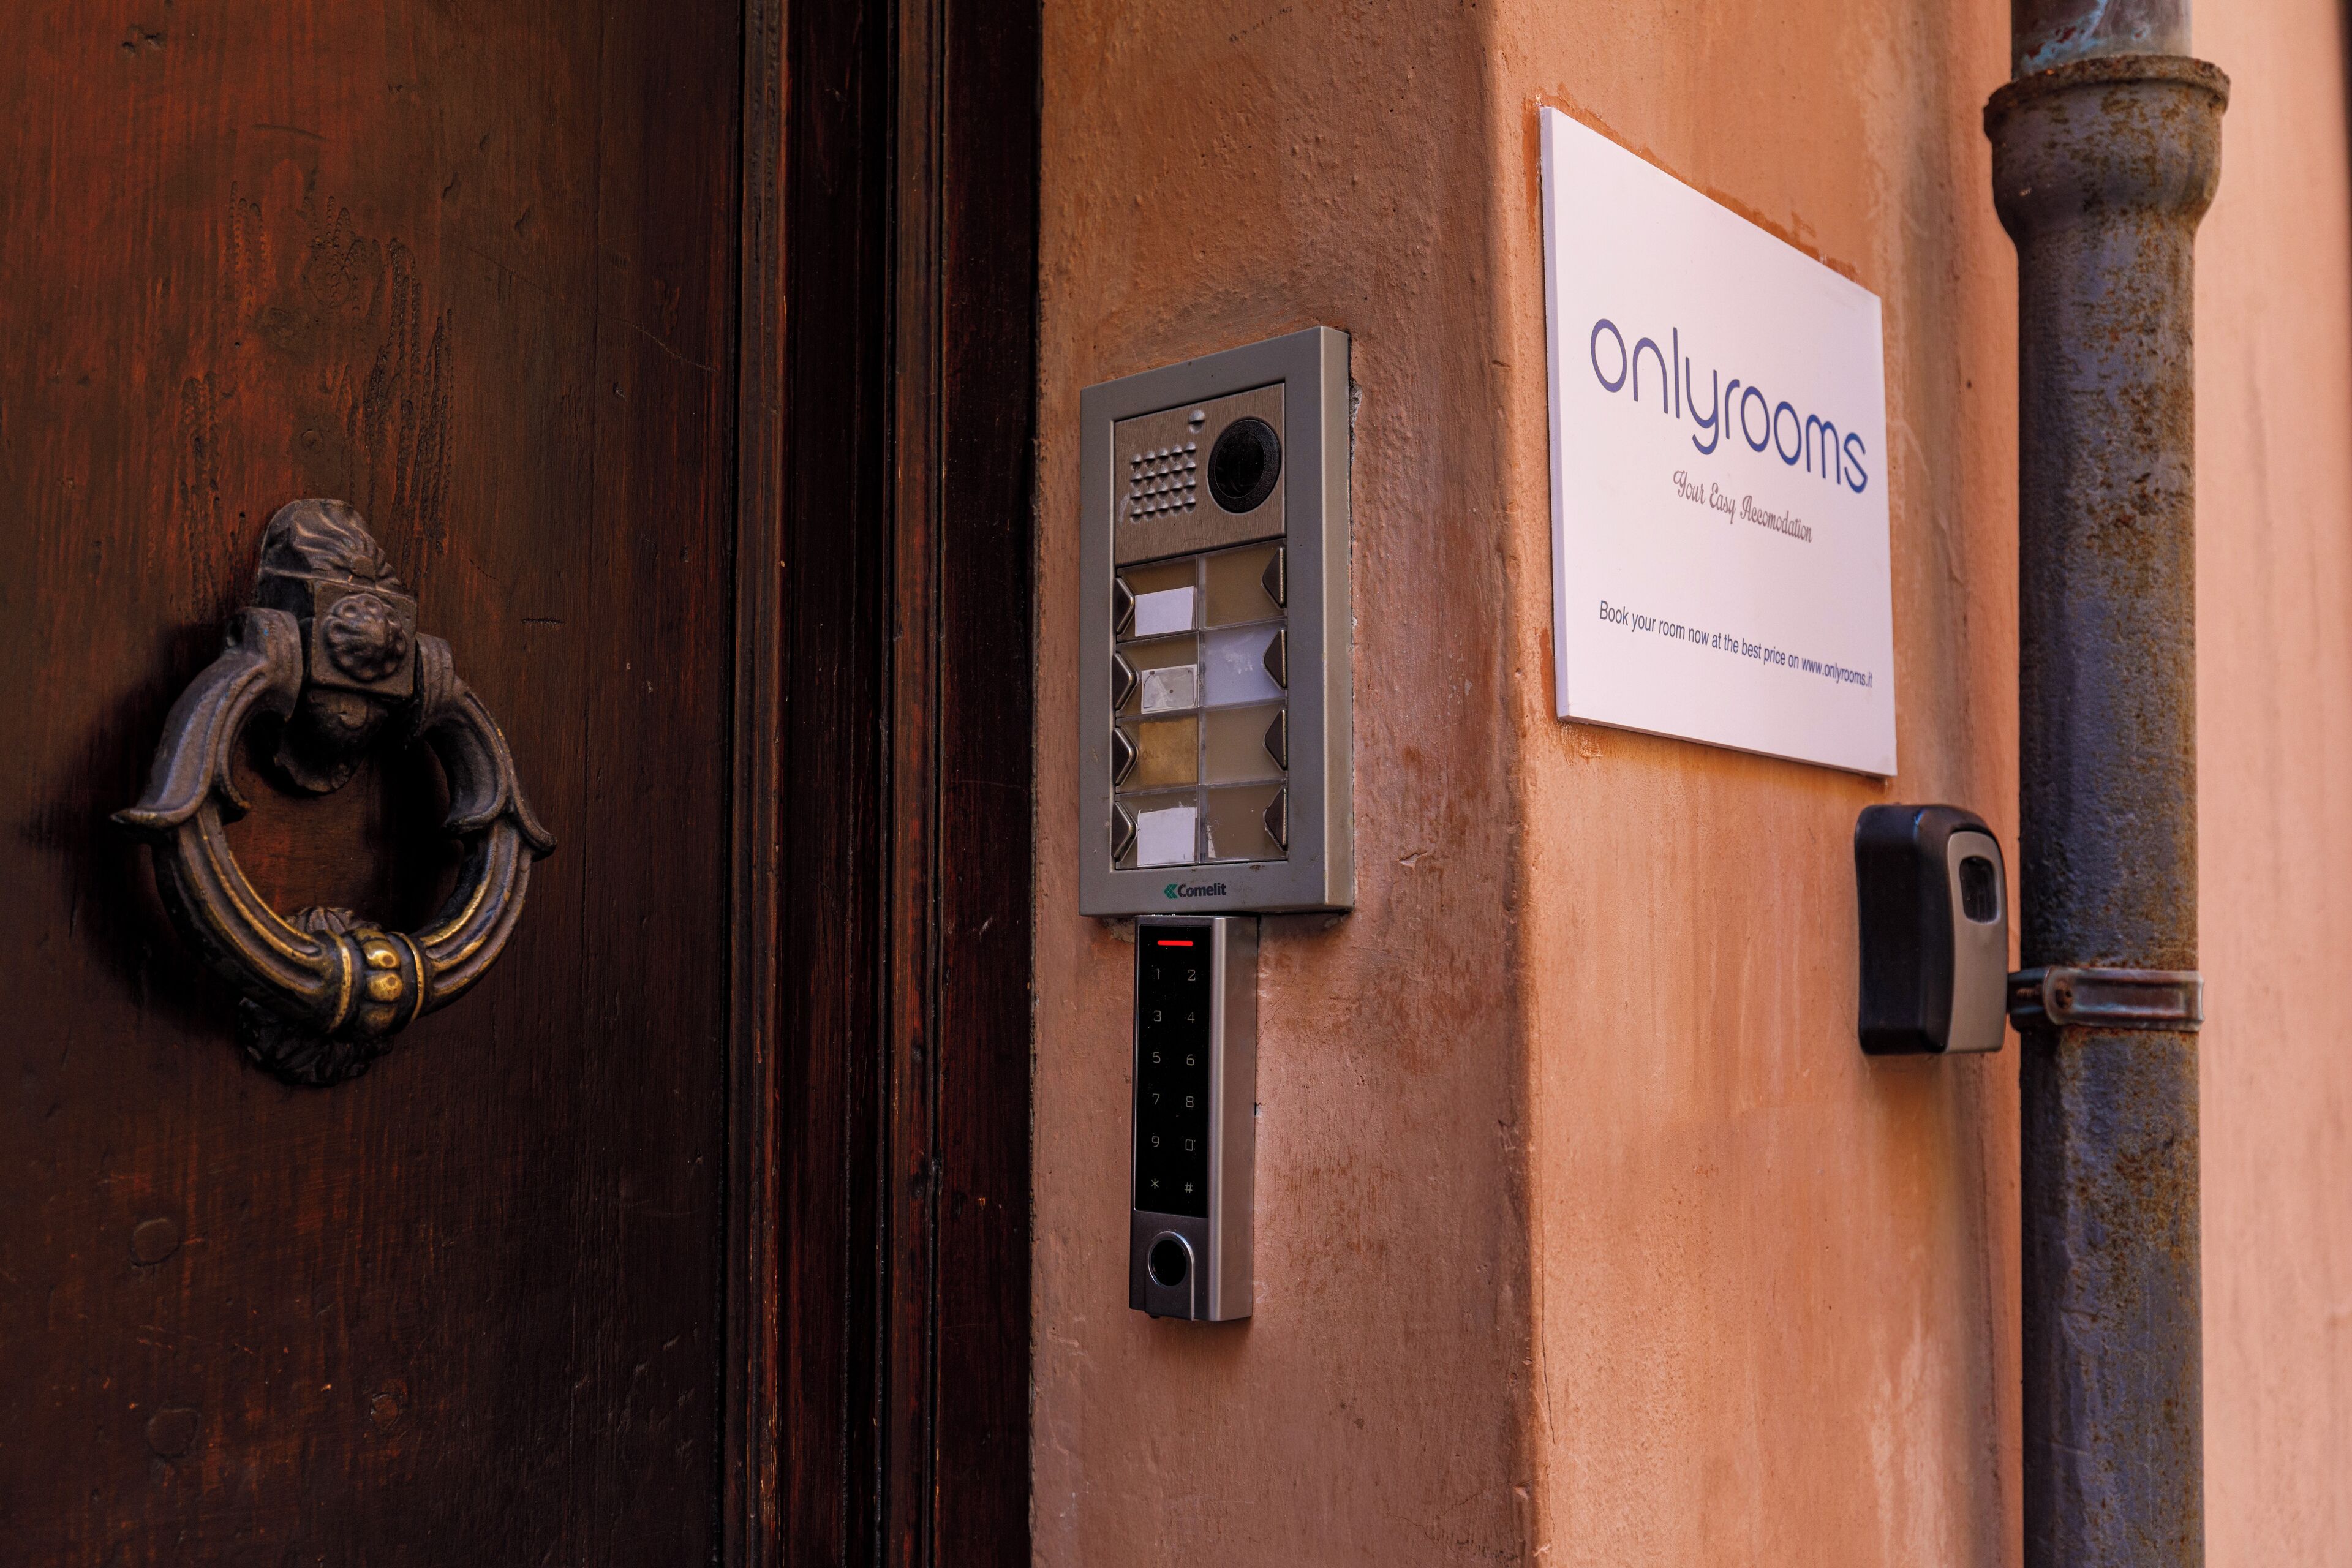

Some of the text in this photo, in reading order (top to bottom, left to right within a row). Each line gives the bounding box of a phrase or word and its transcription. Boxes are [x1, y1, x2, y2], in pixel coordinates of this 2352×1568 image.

[1590, 318, 1868, 494] onlyrooms
[1673, 470, 1812, 543] Your Easy Accomodation
[1599, 600, 1873, 688] Book your room now at the best price on www.onlyrooms.it
[1177, 882, 1227, 898] Comelit
[1188, 969, 1196, 981] 2
[1153, 1010, 1195, 1024] 3 4
[1153, 1052, 1194, 1066] 5 6
[1152, 1093, 1194, 1108] 7 8
[1152, 1136, 1193, 1152] 9 0
